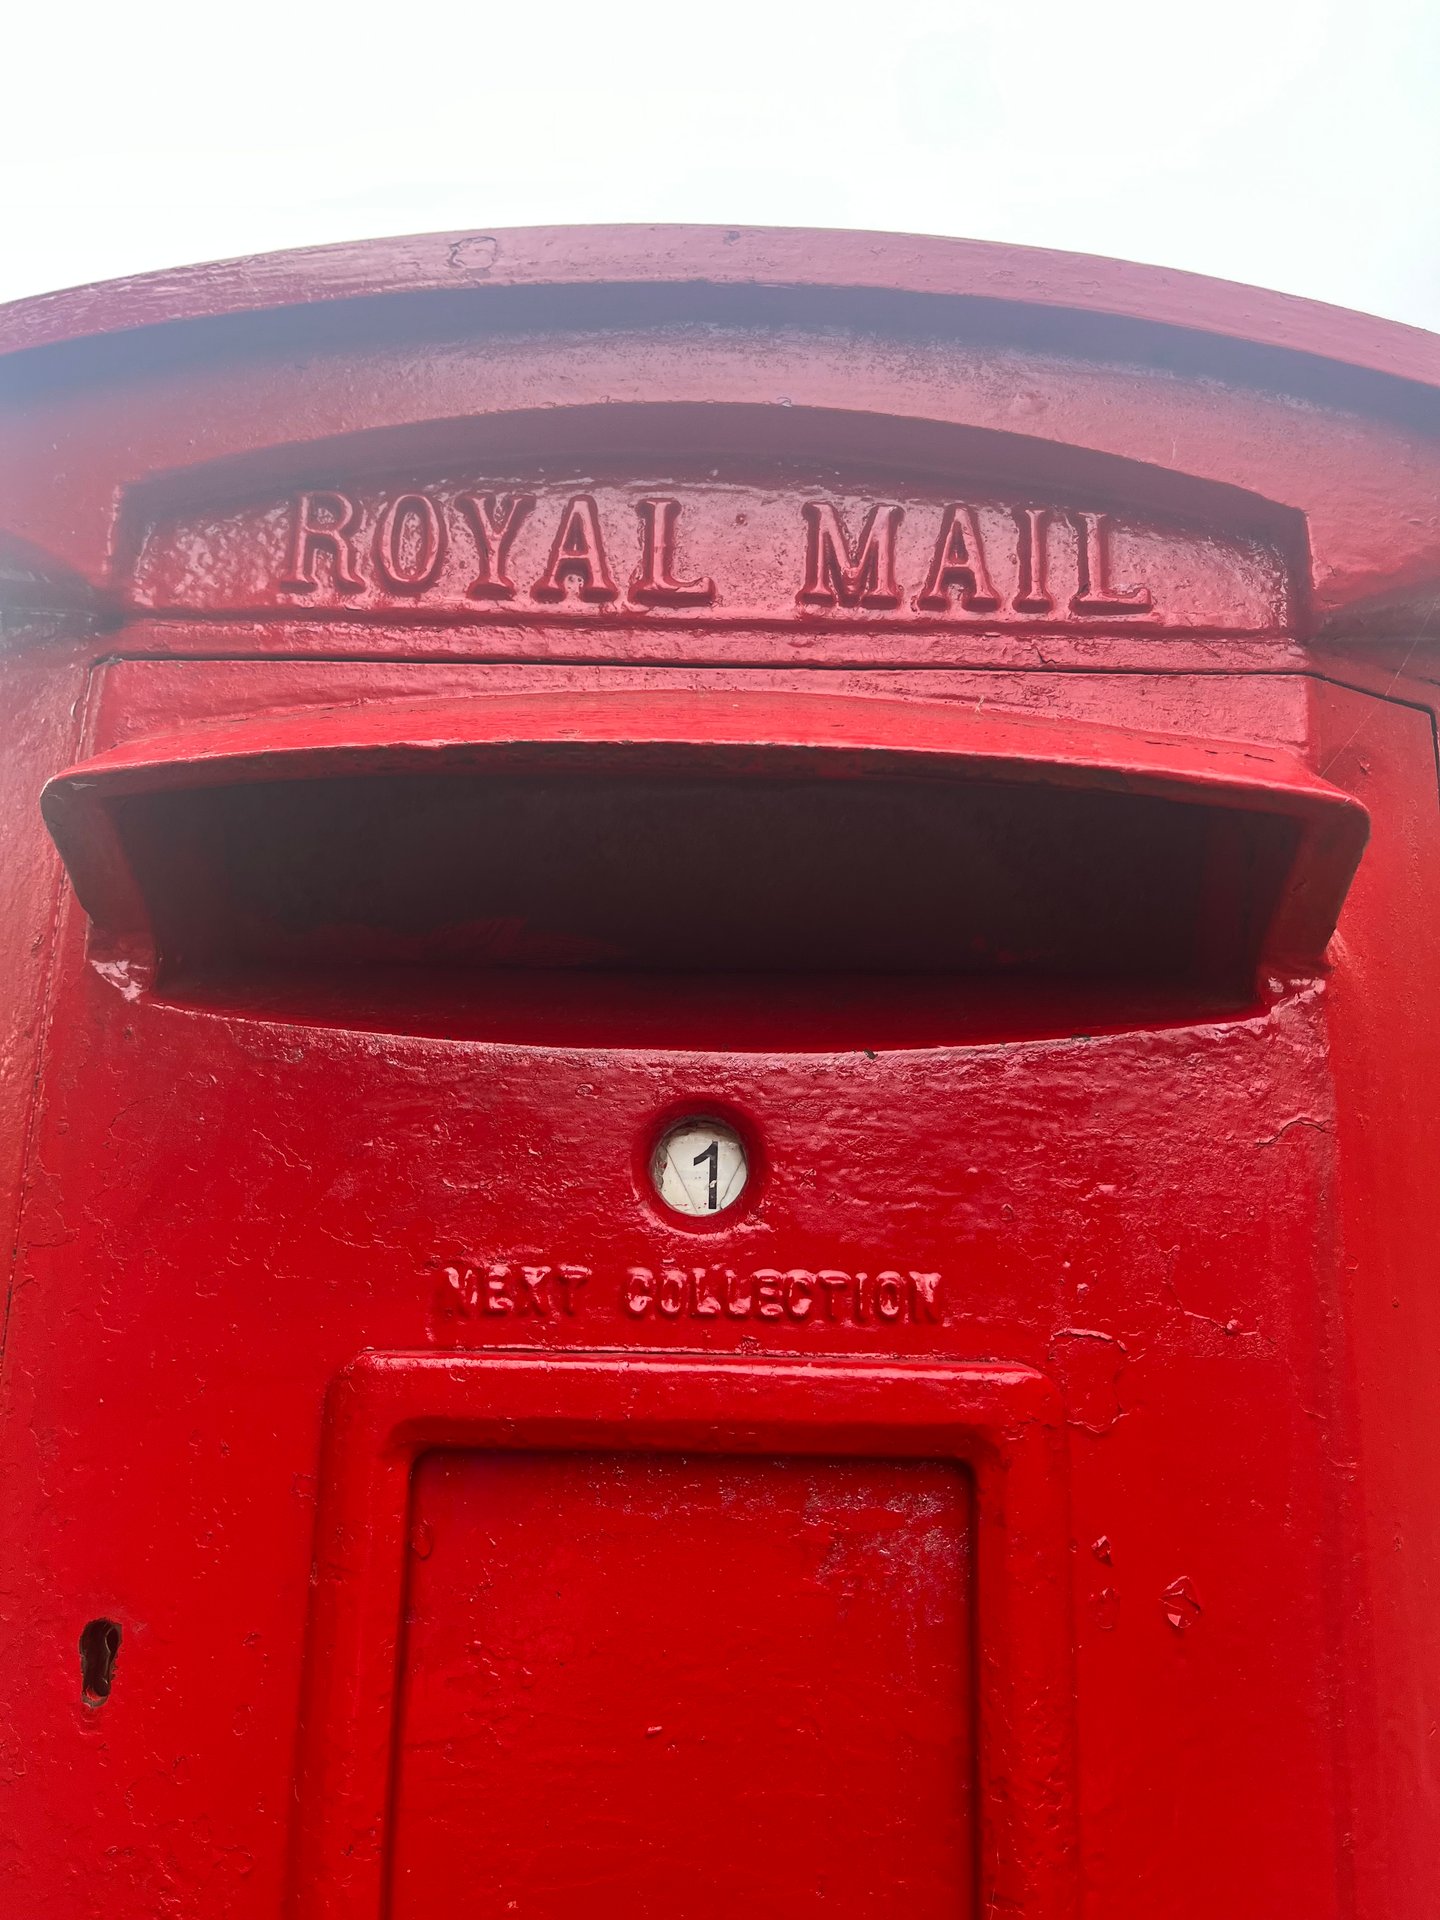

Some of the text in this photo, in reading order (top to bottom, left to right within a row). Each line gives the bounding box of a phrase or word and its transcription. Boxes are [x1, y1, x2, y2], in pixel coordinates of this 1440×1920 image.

[279, 492, 1152, 616] ROYAL MAIL
[693, 1140, 718, 1210] 1
[443, 1263, 942, 1322] NEXT COLLECTION
